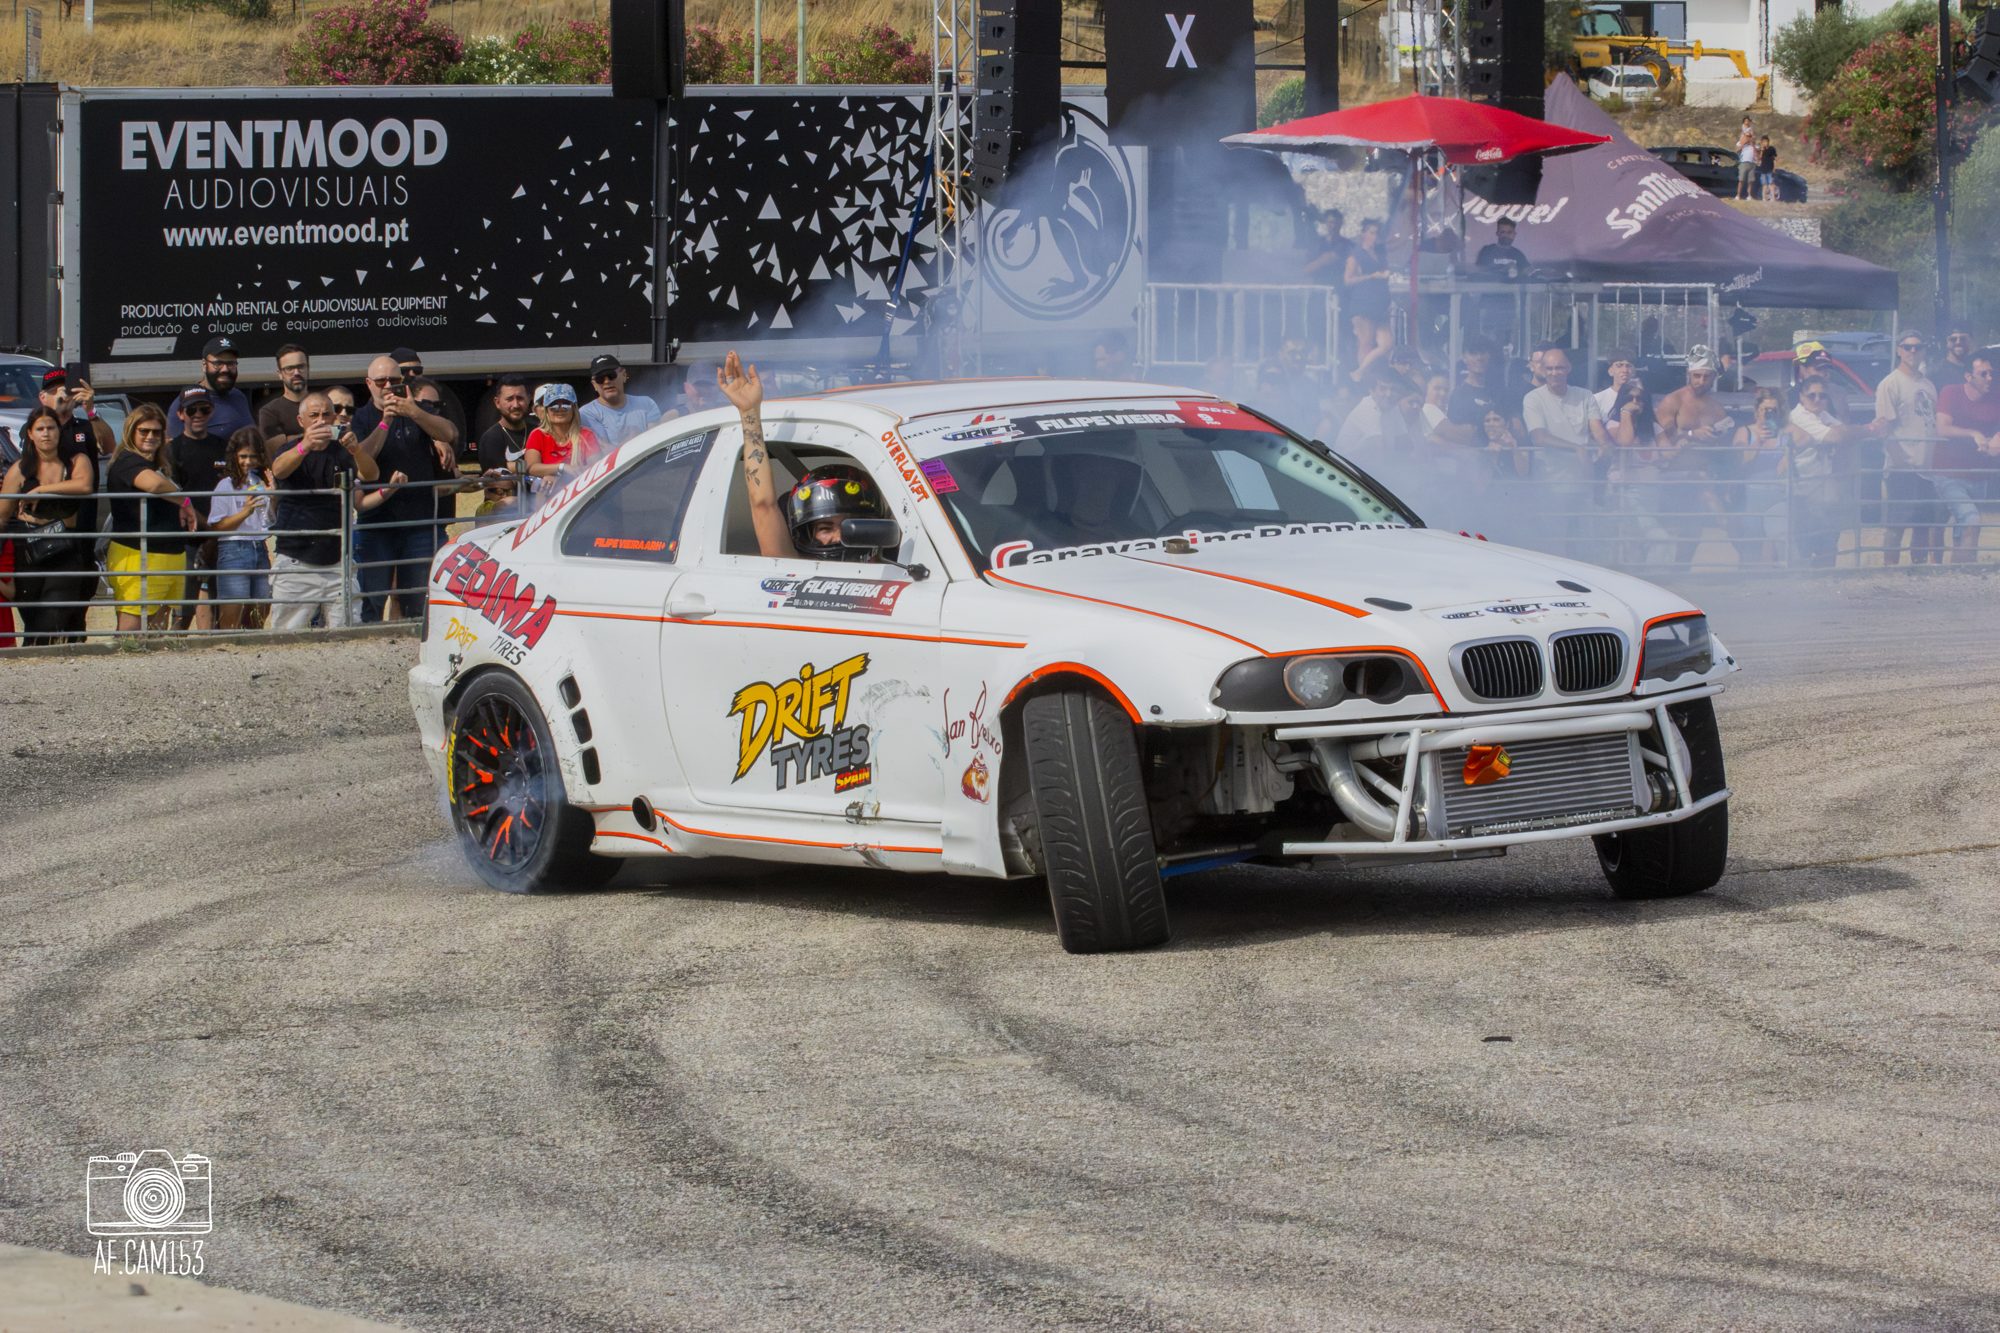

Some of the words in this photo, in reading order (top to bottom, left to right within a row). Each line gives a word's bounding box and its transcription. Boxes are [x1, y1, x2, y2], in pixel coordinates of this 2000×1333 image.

[1165, 13, 1198, 68] X
[121, 118, 448, 171] EVENTMOOD
[163, 174, 409, 210] AUDIOVISUAIS
[163, 217, 410, 248] www.eventmood.pt
[121, 304, 204, 319] PRODUCTION
[206, 302, 233, 316] AND
[236, 300, 280, 316] RENTAL
[282, 299, 300, 314] OF
[301, 297, 379, 313] AUDIOVISUAL
[381, 295, 448, 312] EQUIPMENT
[121, 321, 183, 337] produção
[191, 323, 200, 334] e
[207, 319, 253, 335] aluguer
[262, 317, 278, 331] de
[286, 315, 369, 333] equipamentos
[376, 313, 448, 328] audiovisuais
[952, 423, 1016, 441] DRIFT
[519, 461, 612, 543] MOTUL
[432, 541, 557, 650] FEDIMA
[801, 580, 841, 595] FILIPE
[838, 582, 882, 598] VIEIRA
[885, 585, 899, 598] 9
[1495, 602, 1543, 614] DRIFT
[444, 617, 479, 651] DRIFT
[488, 635, 527, 667] TYRES
[726, 652, 872, 785] DRIFT
[770, 723, 871, 791] TYRES
[835, 766, 871, 791] SPAIN
